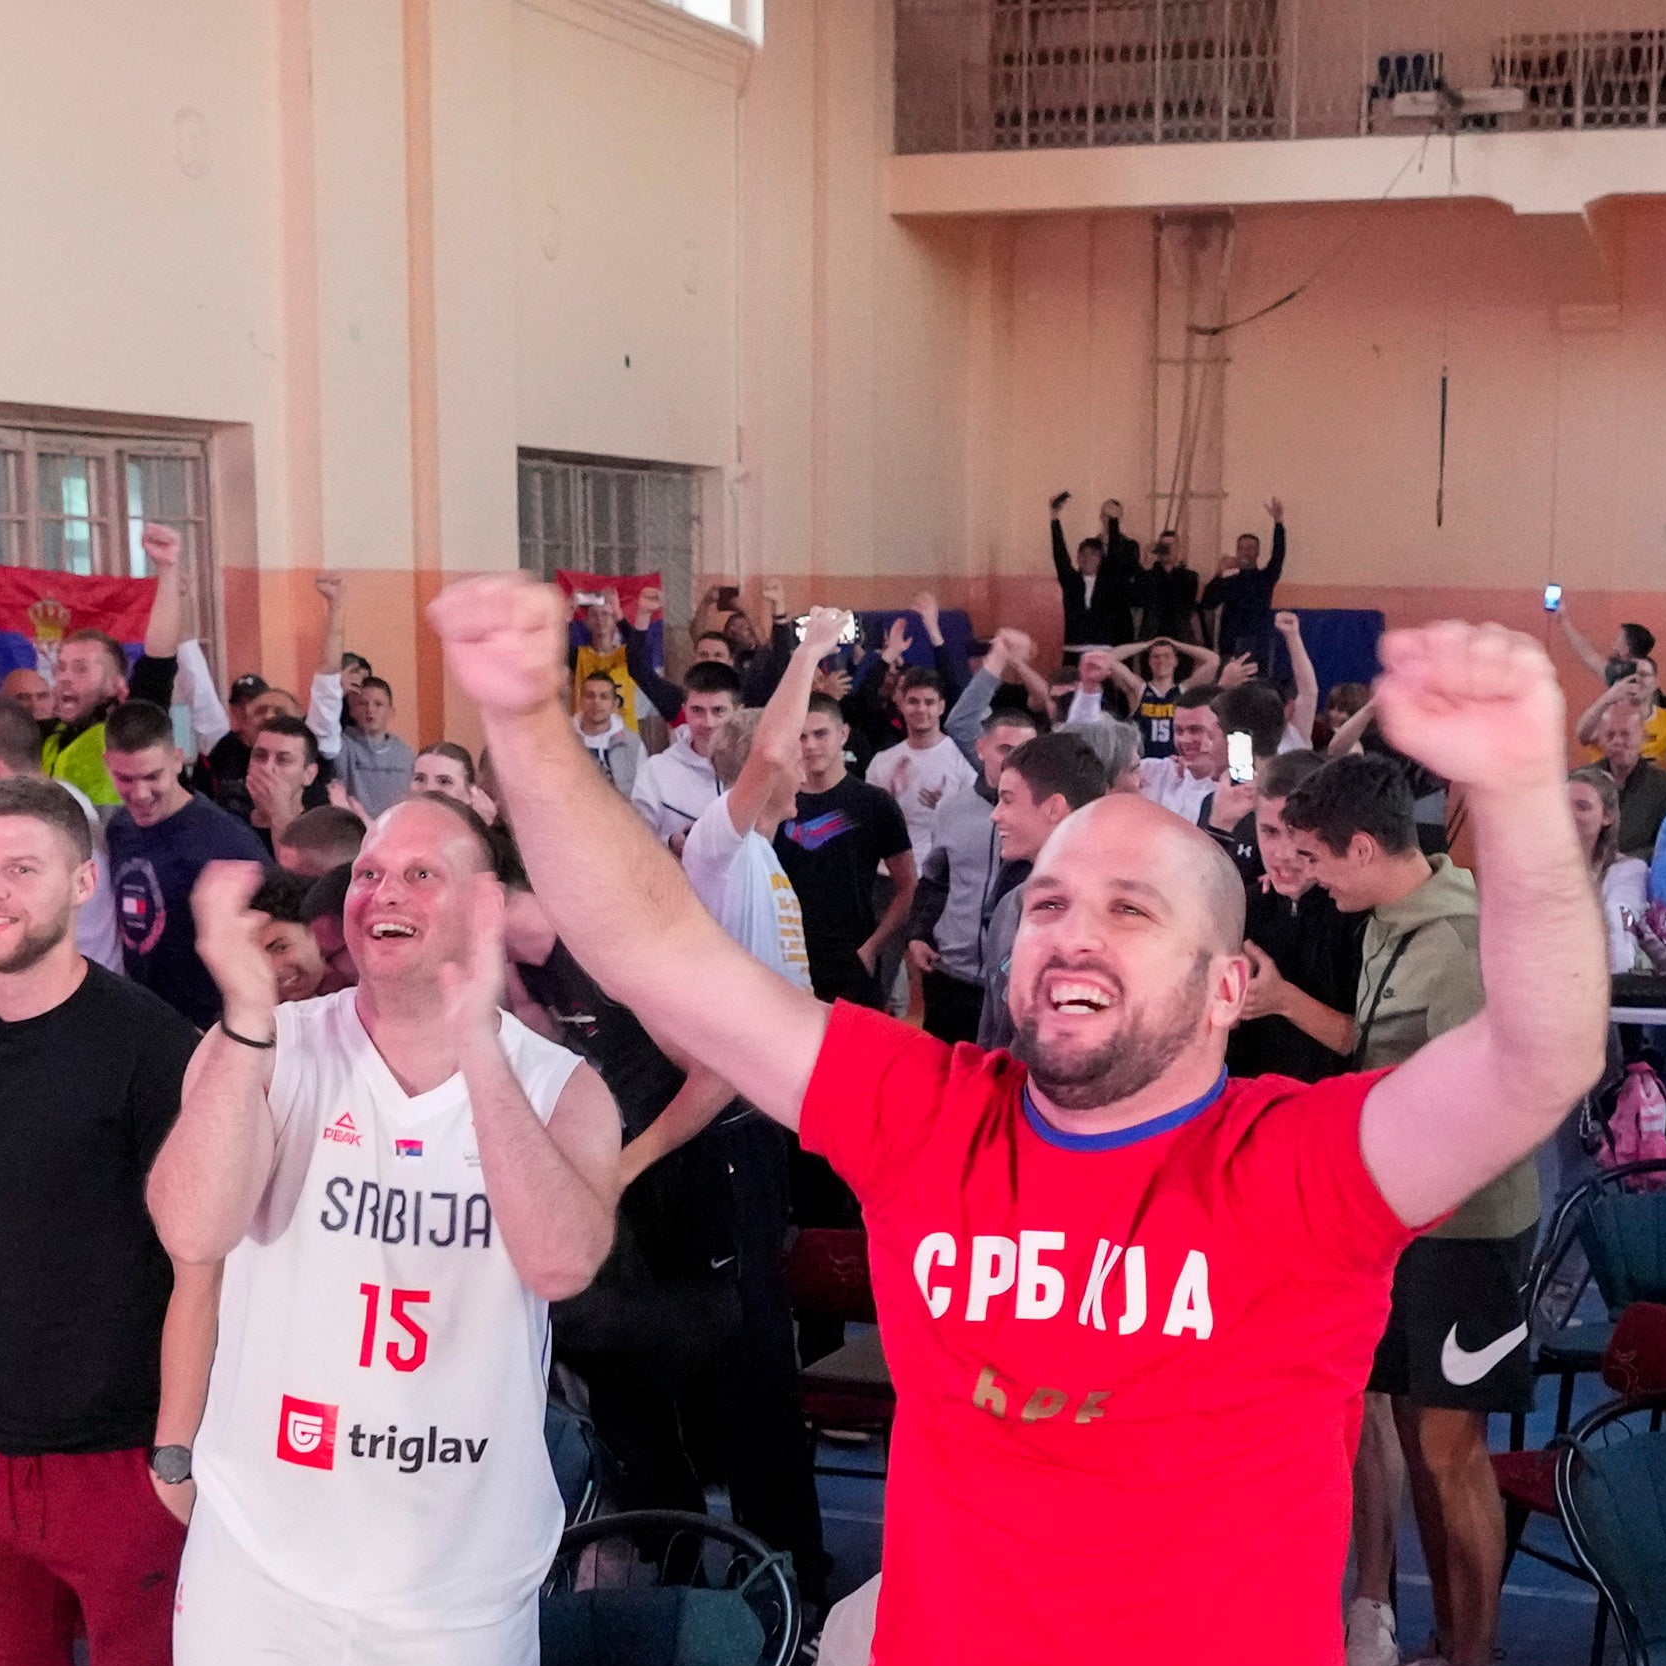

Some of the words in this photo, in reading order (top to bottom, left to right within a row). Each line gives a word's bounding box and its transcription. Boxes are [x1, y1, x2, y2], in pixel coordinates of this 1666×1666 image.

[323, 1127, 362, 1147] PEAK
[320, 1176, 493, 1249] SRBIJA
[358, 1282, 431, 1373] 15
[348, 1423, 489, 1474] triglav
